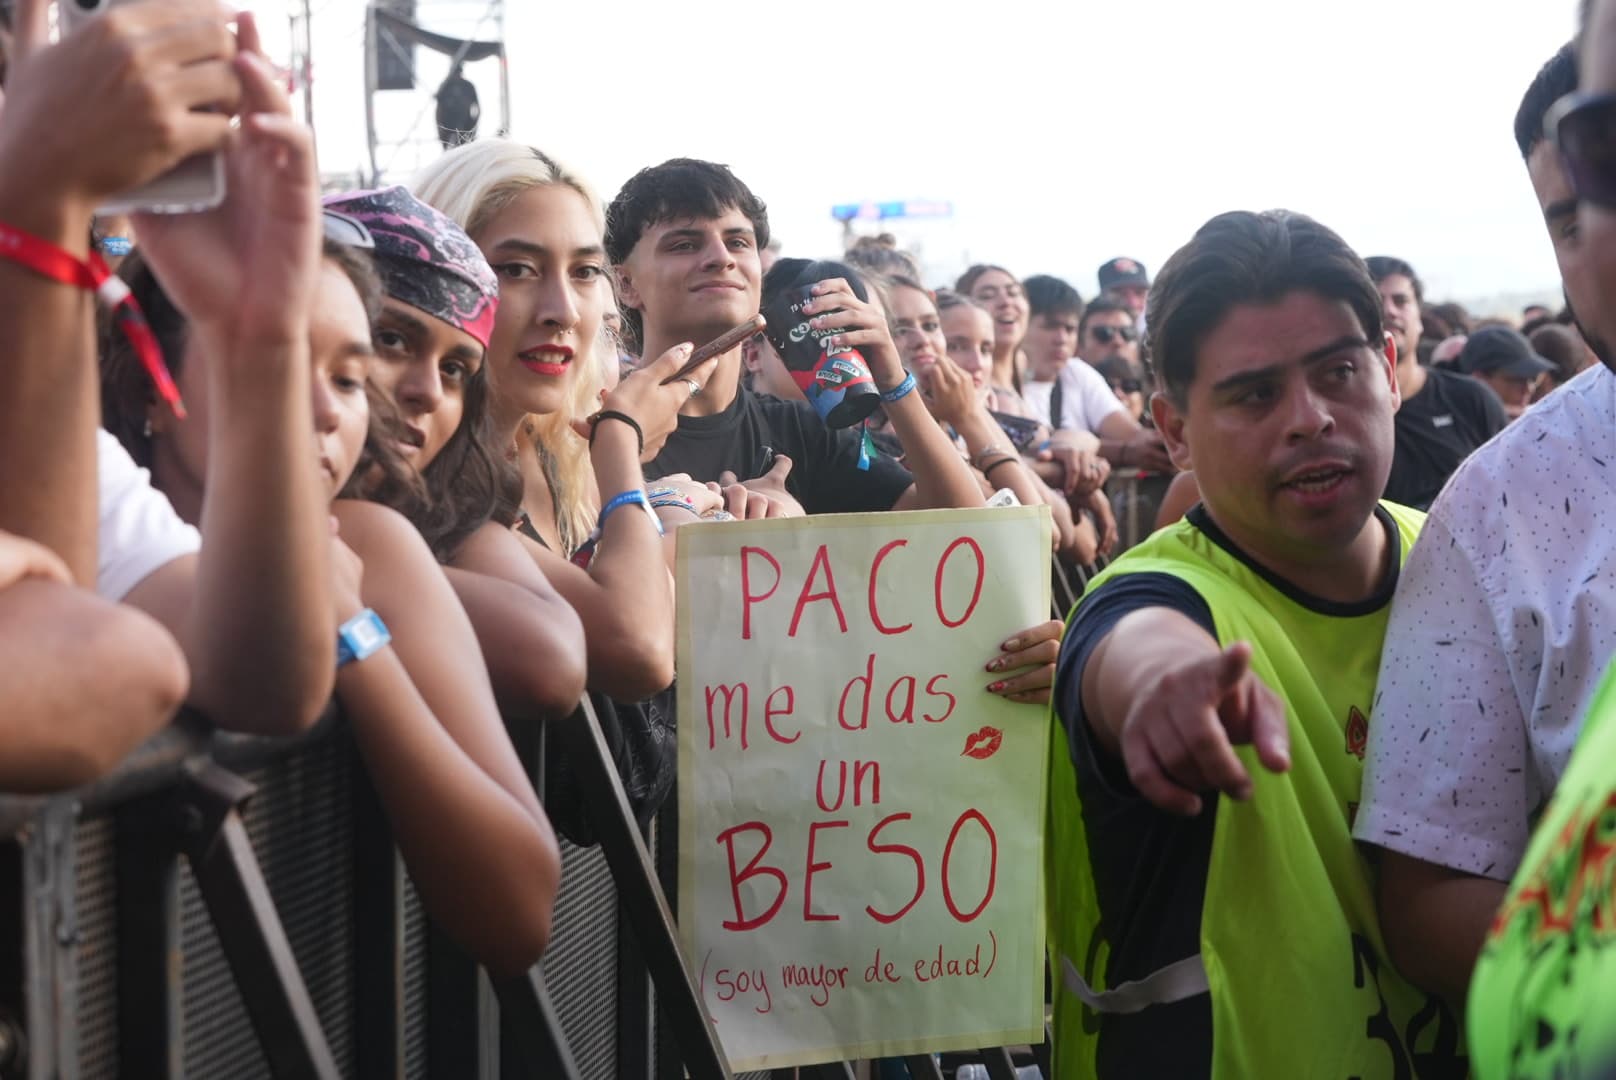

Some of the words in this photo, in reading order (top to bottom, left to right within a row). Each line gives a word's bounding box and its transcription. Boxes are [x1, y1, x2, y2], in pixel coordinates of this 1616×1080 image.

[741, 536, 985, 640] PACO
[704, 682, 801, 750] me
[838, 653, 956, 731] das
[816, 759, 881, 813] un
[716, 808, 998, 932] BESO
[782, 963, 849, 1007] mayor
[864, 948, 901, 983] de
[914, 930, 997, 982] edad)
